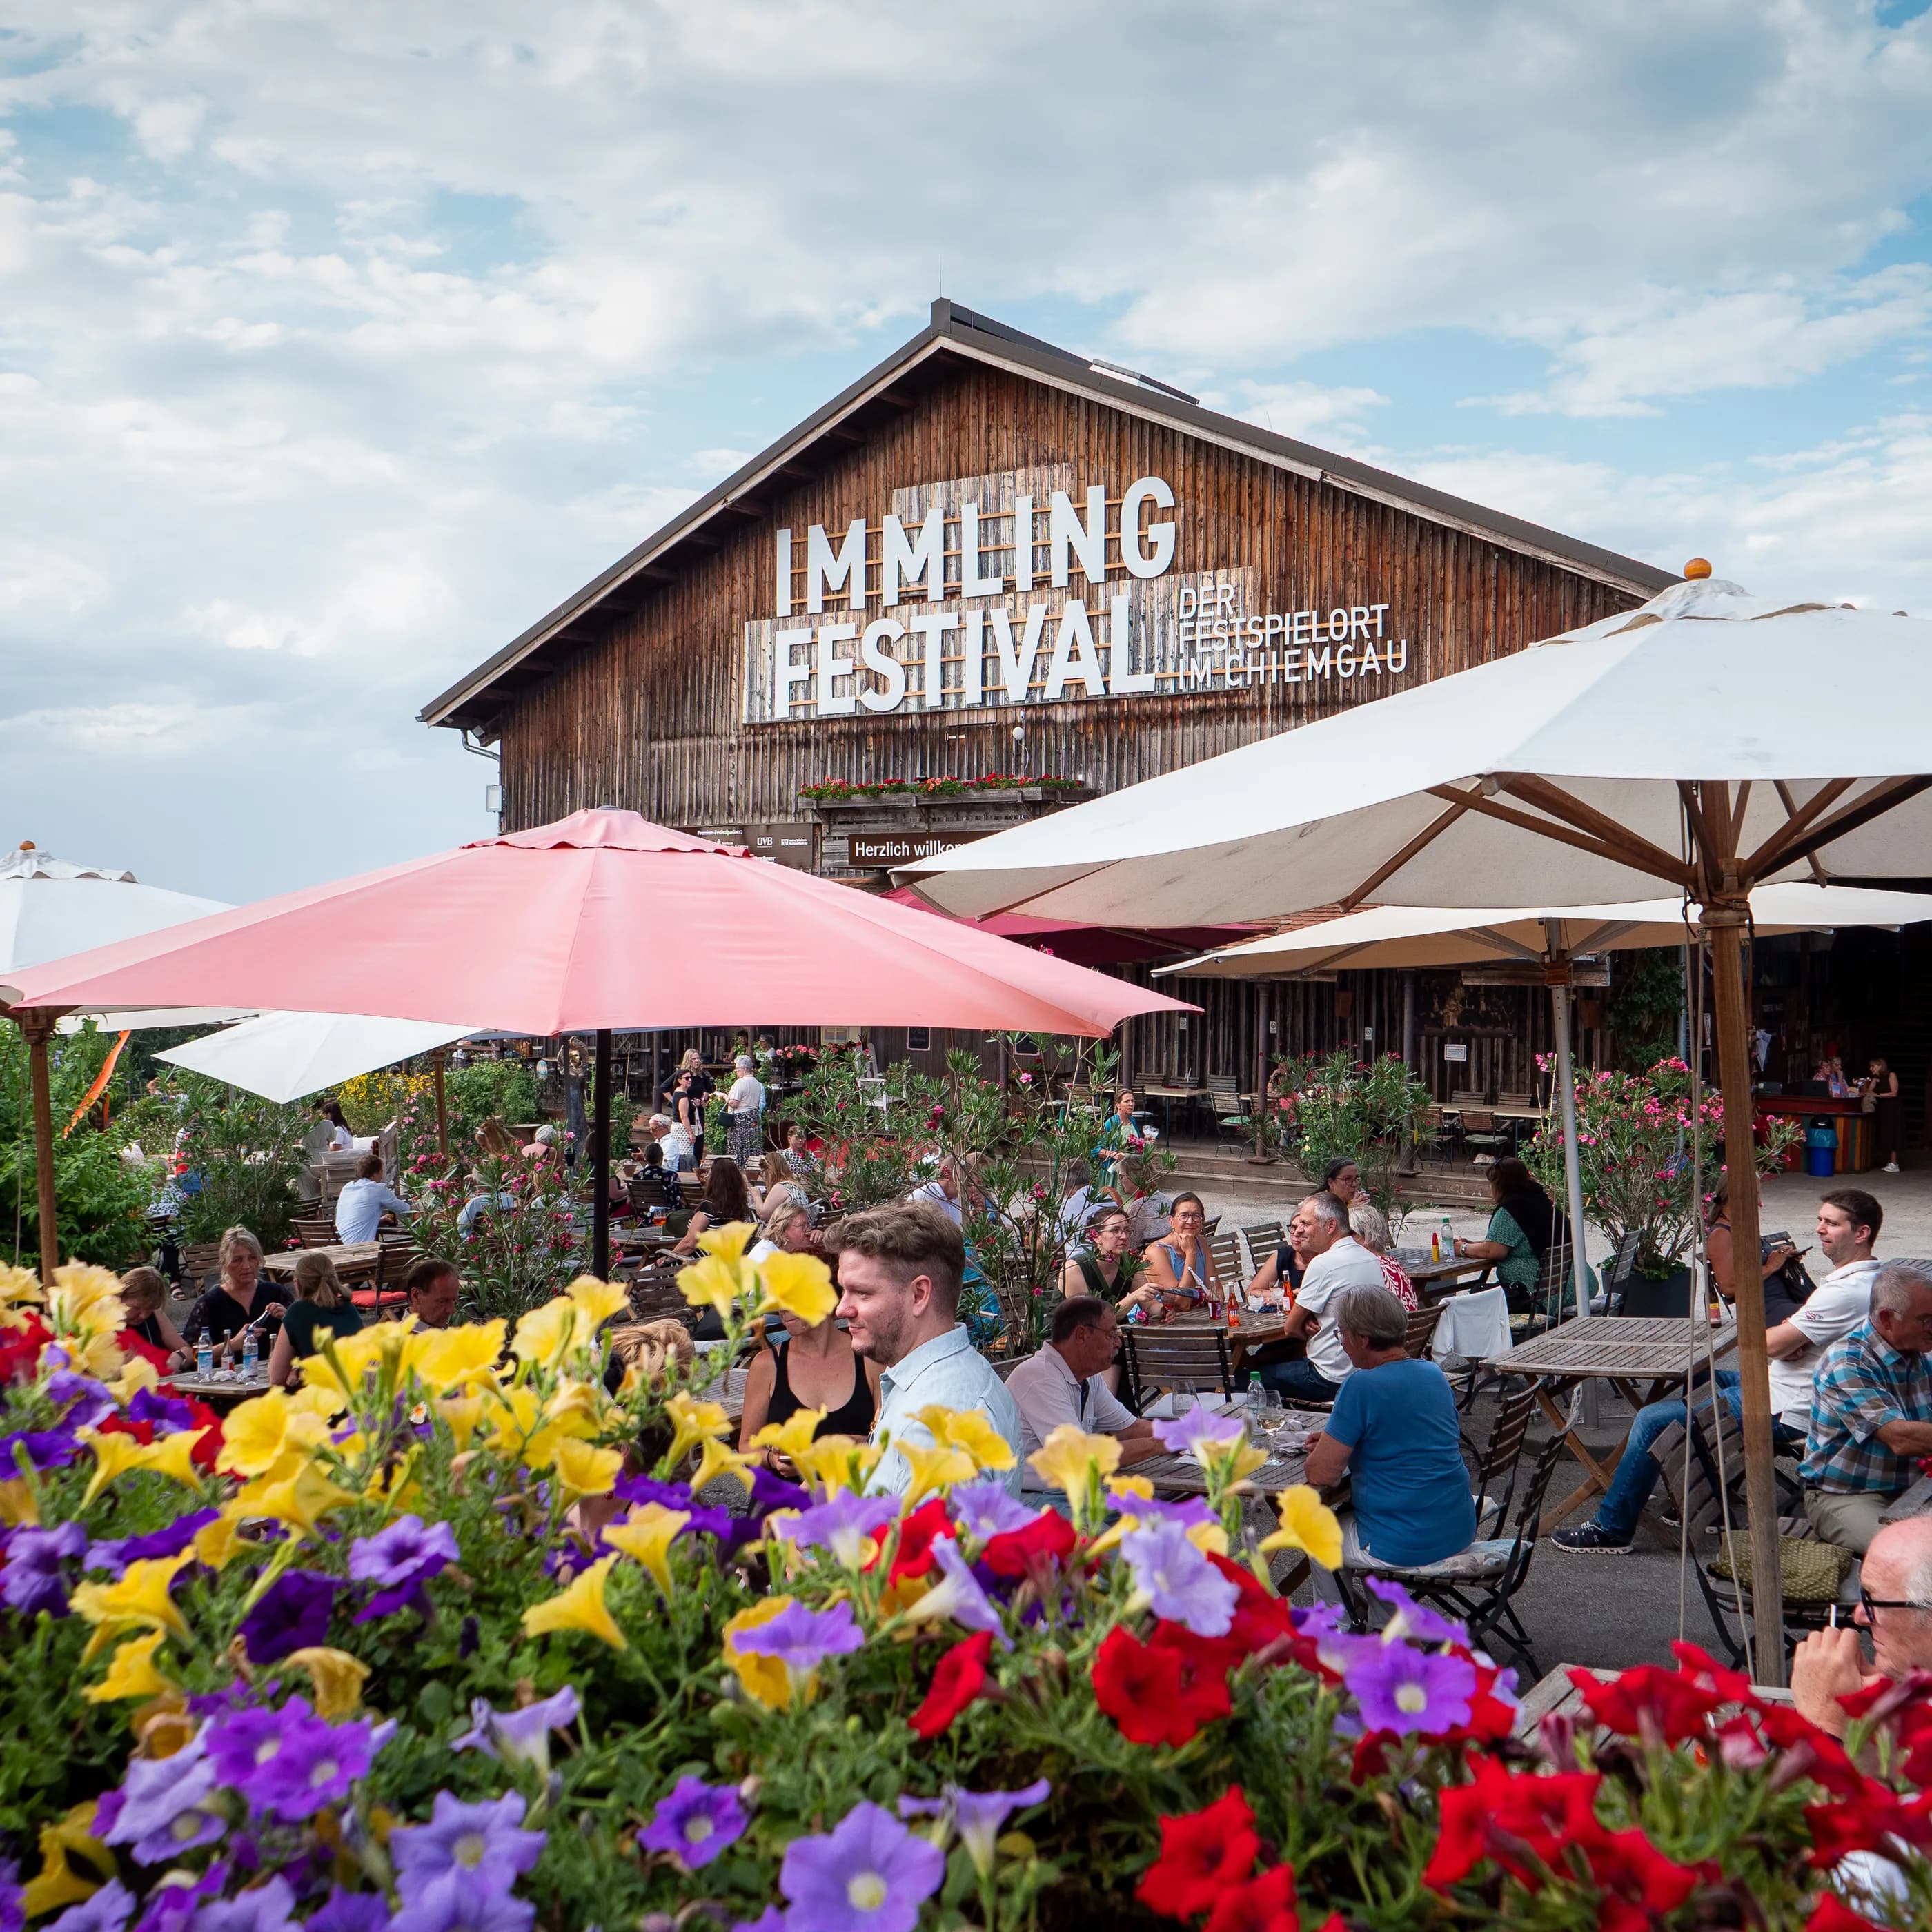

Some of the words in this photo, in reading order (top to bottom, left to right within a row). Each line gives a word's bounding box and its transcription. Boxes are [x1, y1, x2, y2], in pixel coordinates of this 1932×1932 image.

[776, 475, 1176, 618] IMMLING
[1179, 584, 1235, 620] DER
[1179, 603, 1390, 655] FESTSPIELORT
[774, 594, 1156, 718] FESTIVAL
[1179, 656, 1212, 690] IM
[1225, 638, 1408, 687] CHIEMGAU
[757, 836, 773, 845] OVB
[855, 840, 910, 857] Herzlich
